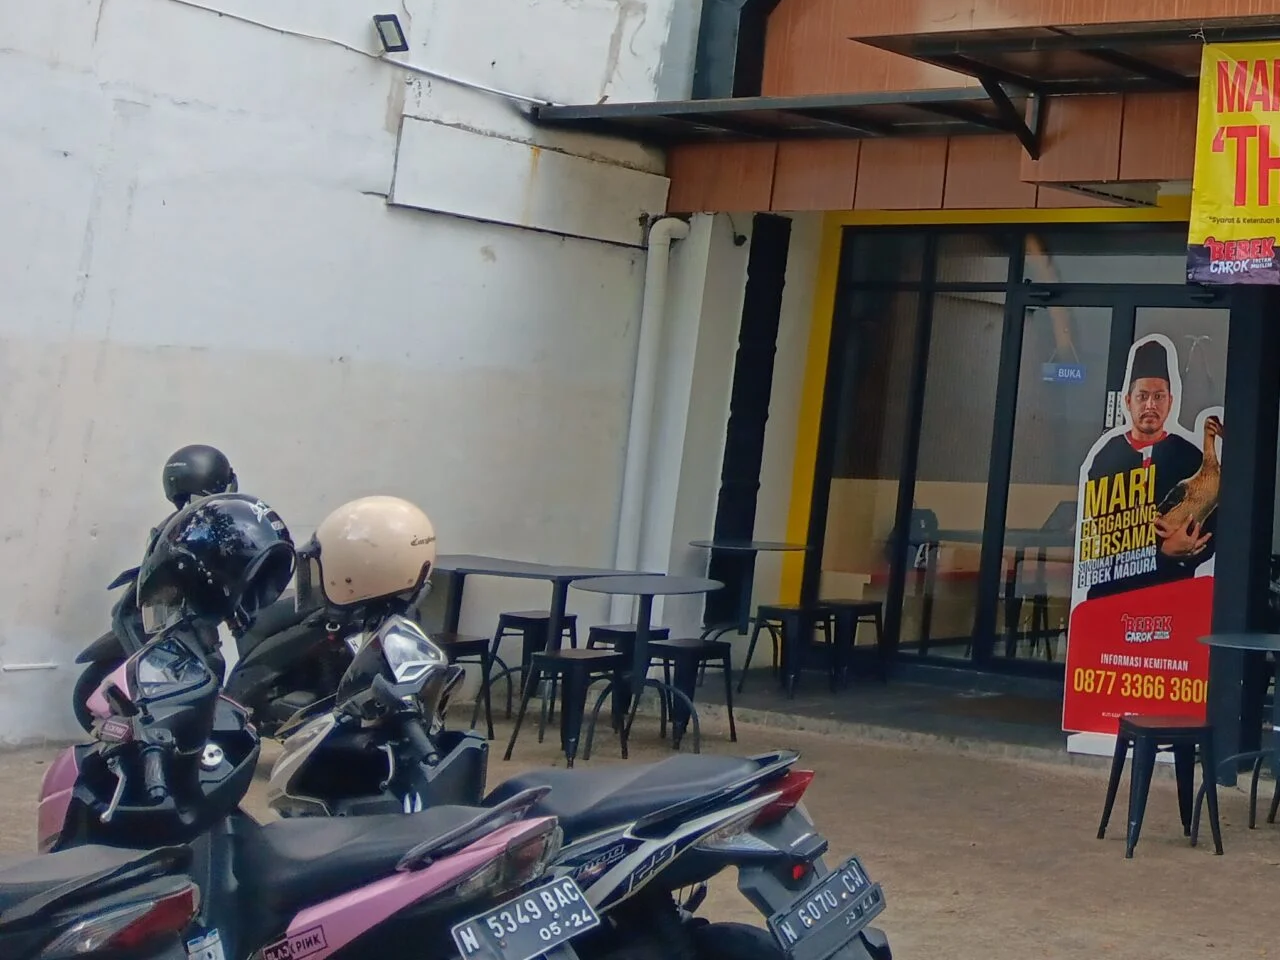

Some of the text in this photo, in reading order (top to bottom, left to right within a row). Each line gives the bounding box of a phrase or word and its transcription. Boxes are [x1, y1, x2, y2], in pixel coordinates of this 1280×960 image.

[1204, 237, 1275, 261] BEBEK
[1210, 259, 1250, 275] CAROK
[1058, 368, 1081, 379] BUKA
[1084, 464, 1157, 518] MARI
[1082, 504, 1157, 539] BERGABUNG
[1080, 523, 1157, 561] BERSAMA
[1079, 545, 1157, 573] SINDIKAT PEDAGANG
[1079, 557, 1157, 589] BEBEK MADURA
[1121, 613, 1172, 632] BEBEK
[1125, 631, 1153, 643] CAROK
[1101, 652, 1189, 672] INFORMASI KEMITRAAN
[1074, 668, 1208, 704] 0877 3366 360
[459, 882, 579, 953] N 5349 BAC
[780, 921, 798, 944] N
[798, 889, 838, 928] 6070
[842, 866, 864, 893] CW
